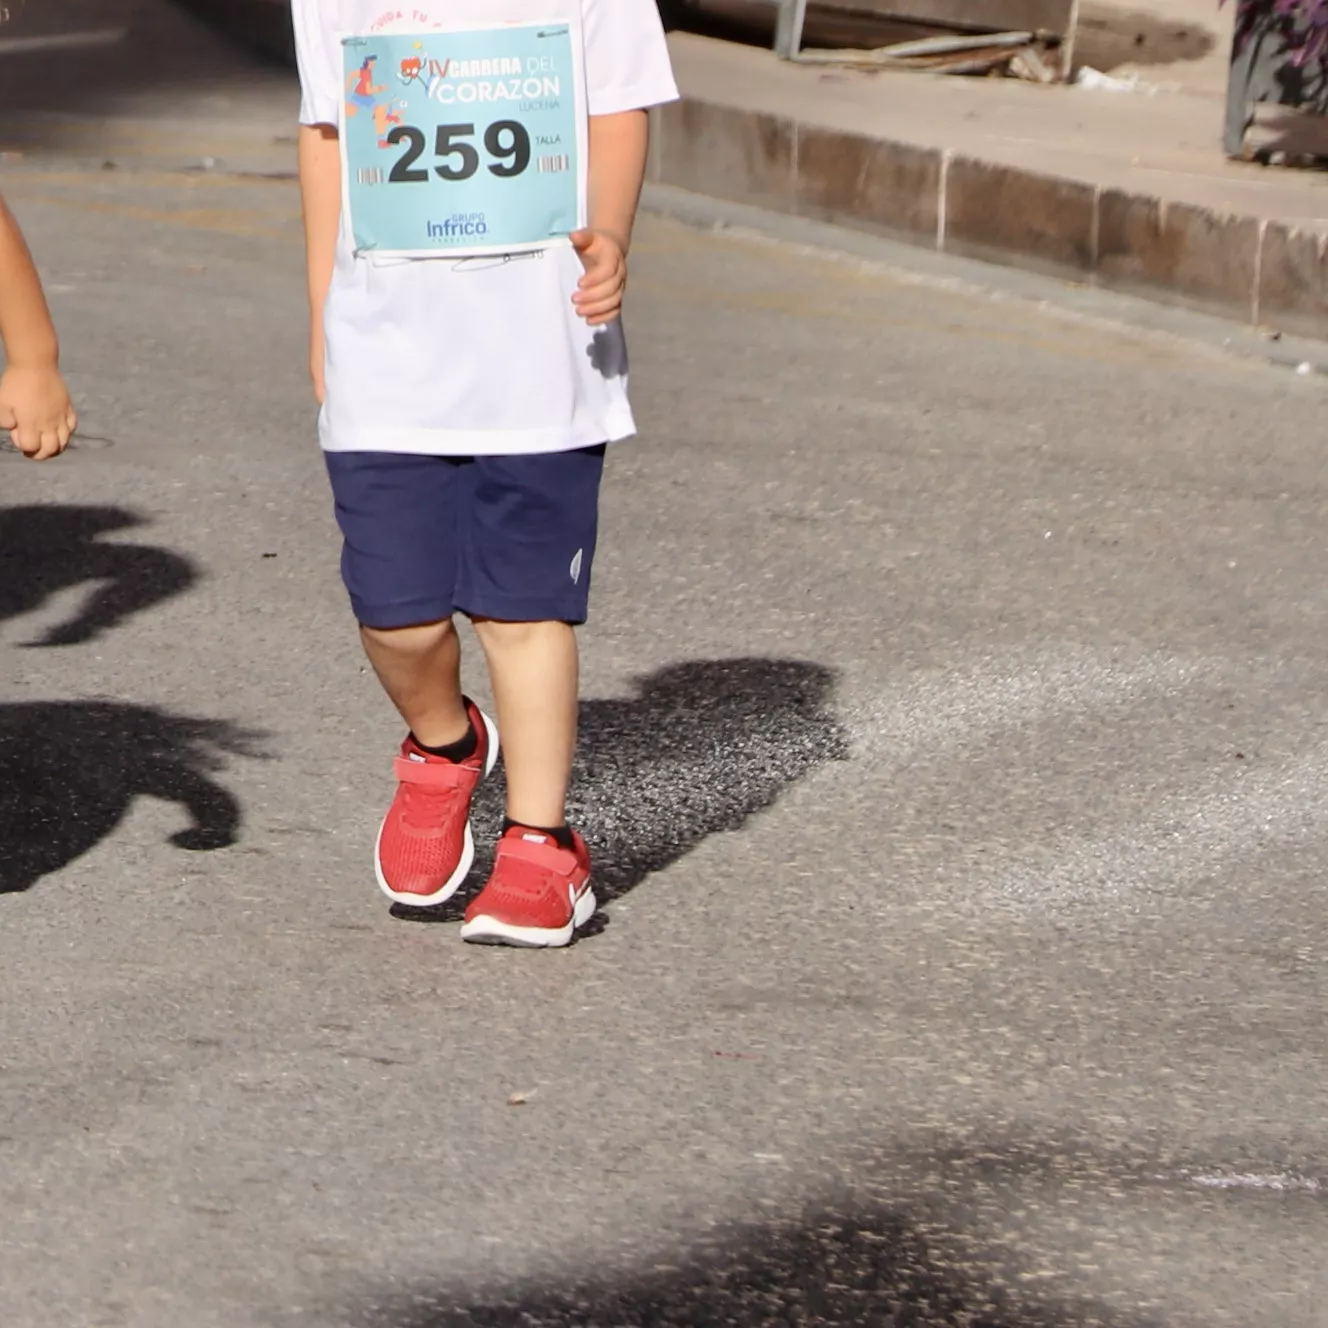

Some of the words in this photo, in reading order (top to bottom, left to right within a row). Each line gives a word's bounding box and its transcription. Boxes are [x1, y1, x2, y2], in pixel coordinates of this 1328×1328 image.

[429, 58, 450, 78] IV
[526, 56, 555, 72] DEL
[436, 73, 561, 104] CORAZÓN
[536, 135, 561, 145] TALLA
[387, 120, 531, 183] 259
[427, 219, 487, 237] Infrico
